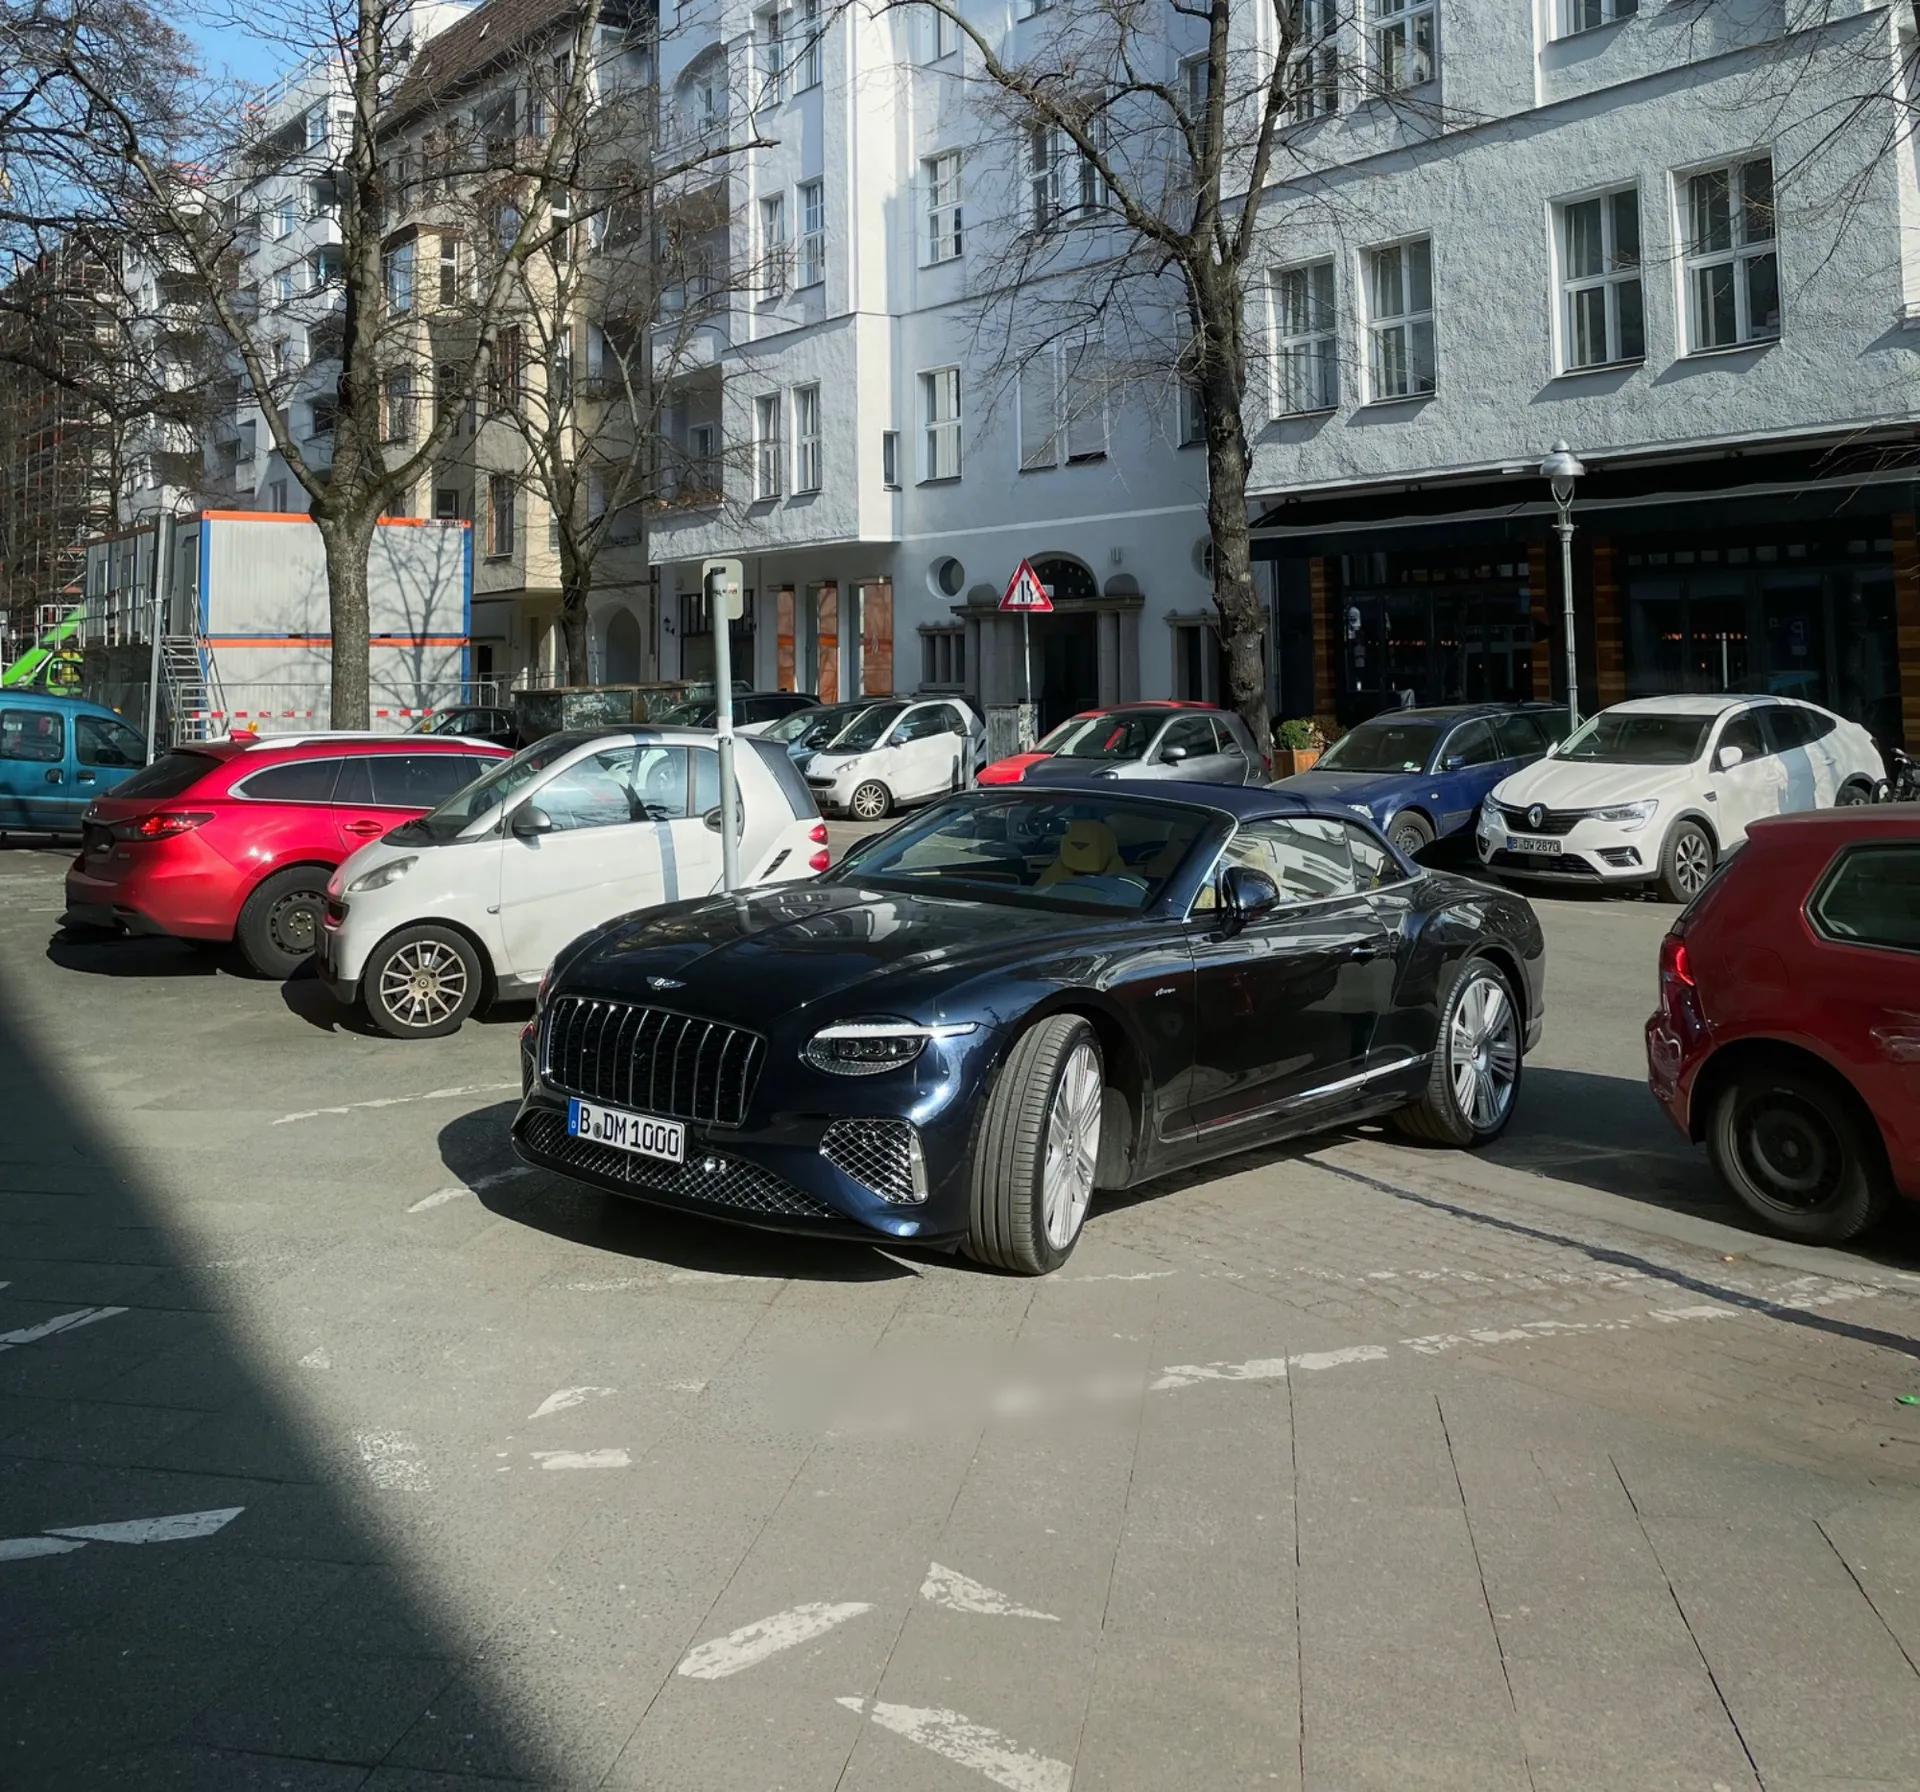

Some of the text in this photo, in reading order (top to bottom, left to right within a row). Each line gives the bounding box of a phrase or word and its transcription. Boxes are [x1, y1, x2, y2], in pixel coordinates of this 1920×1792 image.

[580, 1106, 680, 1157] B DM 1000
